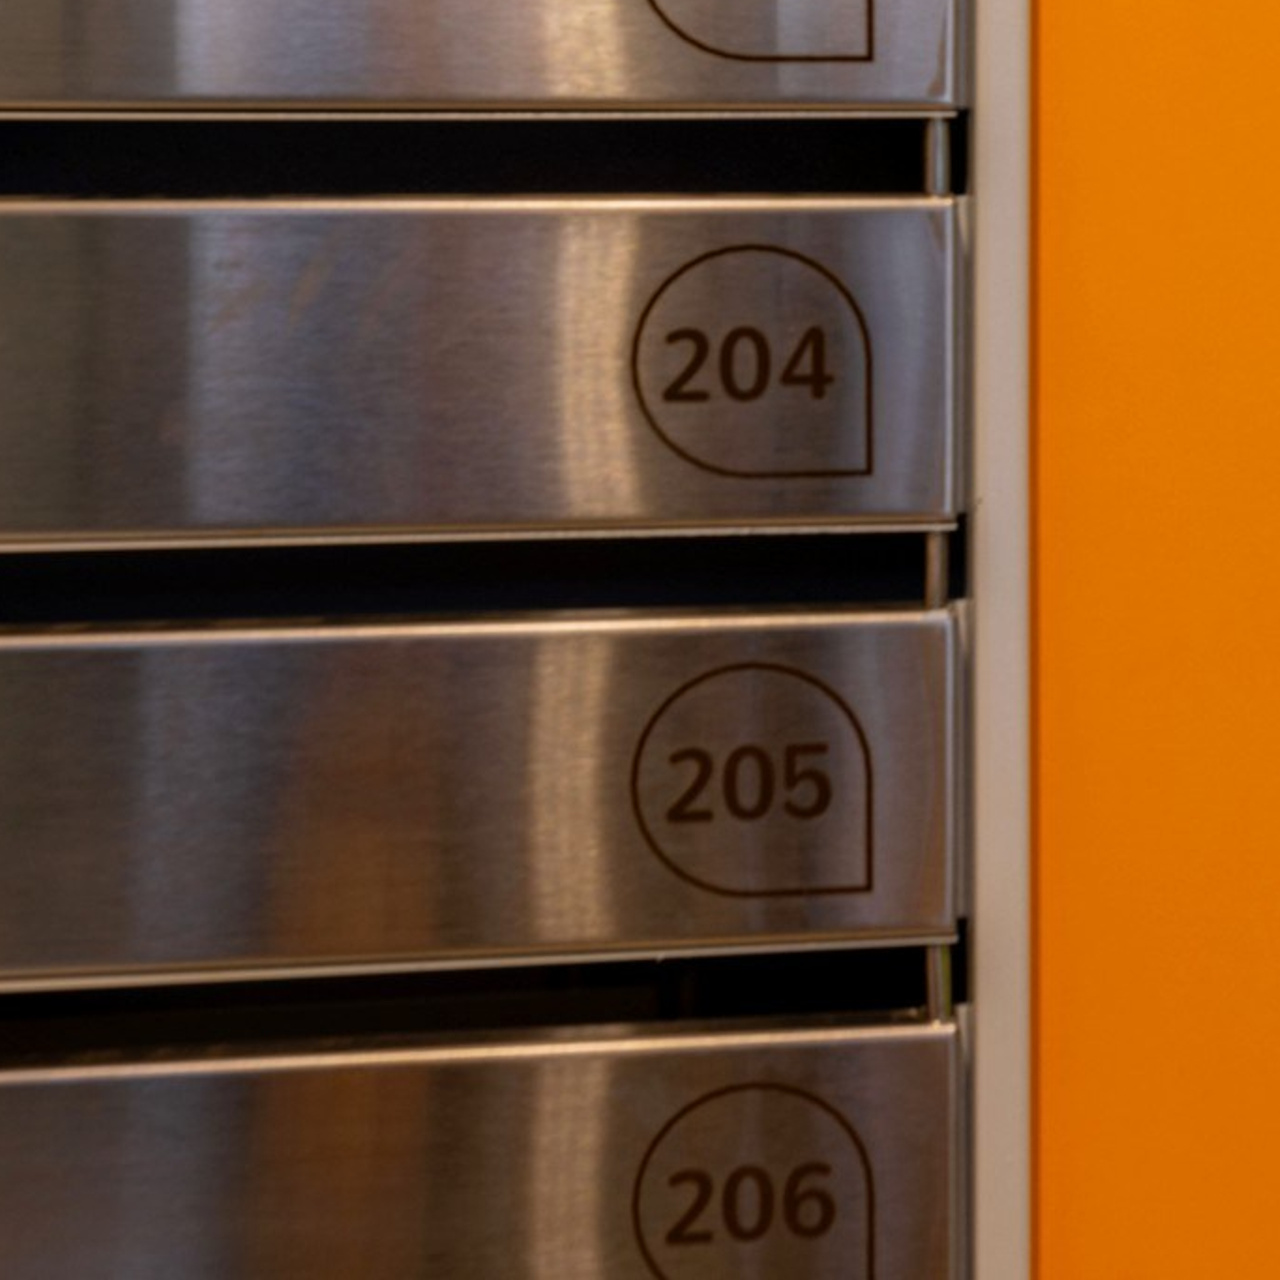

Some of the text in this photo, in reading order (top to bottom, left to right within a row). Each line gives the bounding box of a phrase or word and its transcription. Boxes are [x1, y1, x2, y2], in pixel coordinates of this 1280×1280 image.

[662, 326, 834, 403] 204
[666, 744, 832, 824] 205
[665, 1162, 836, 1246] 206
